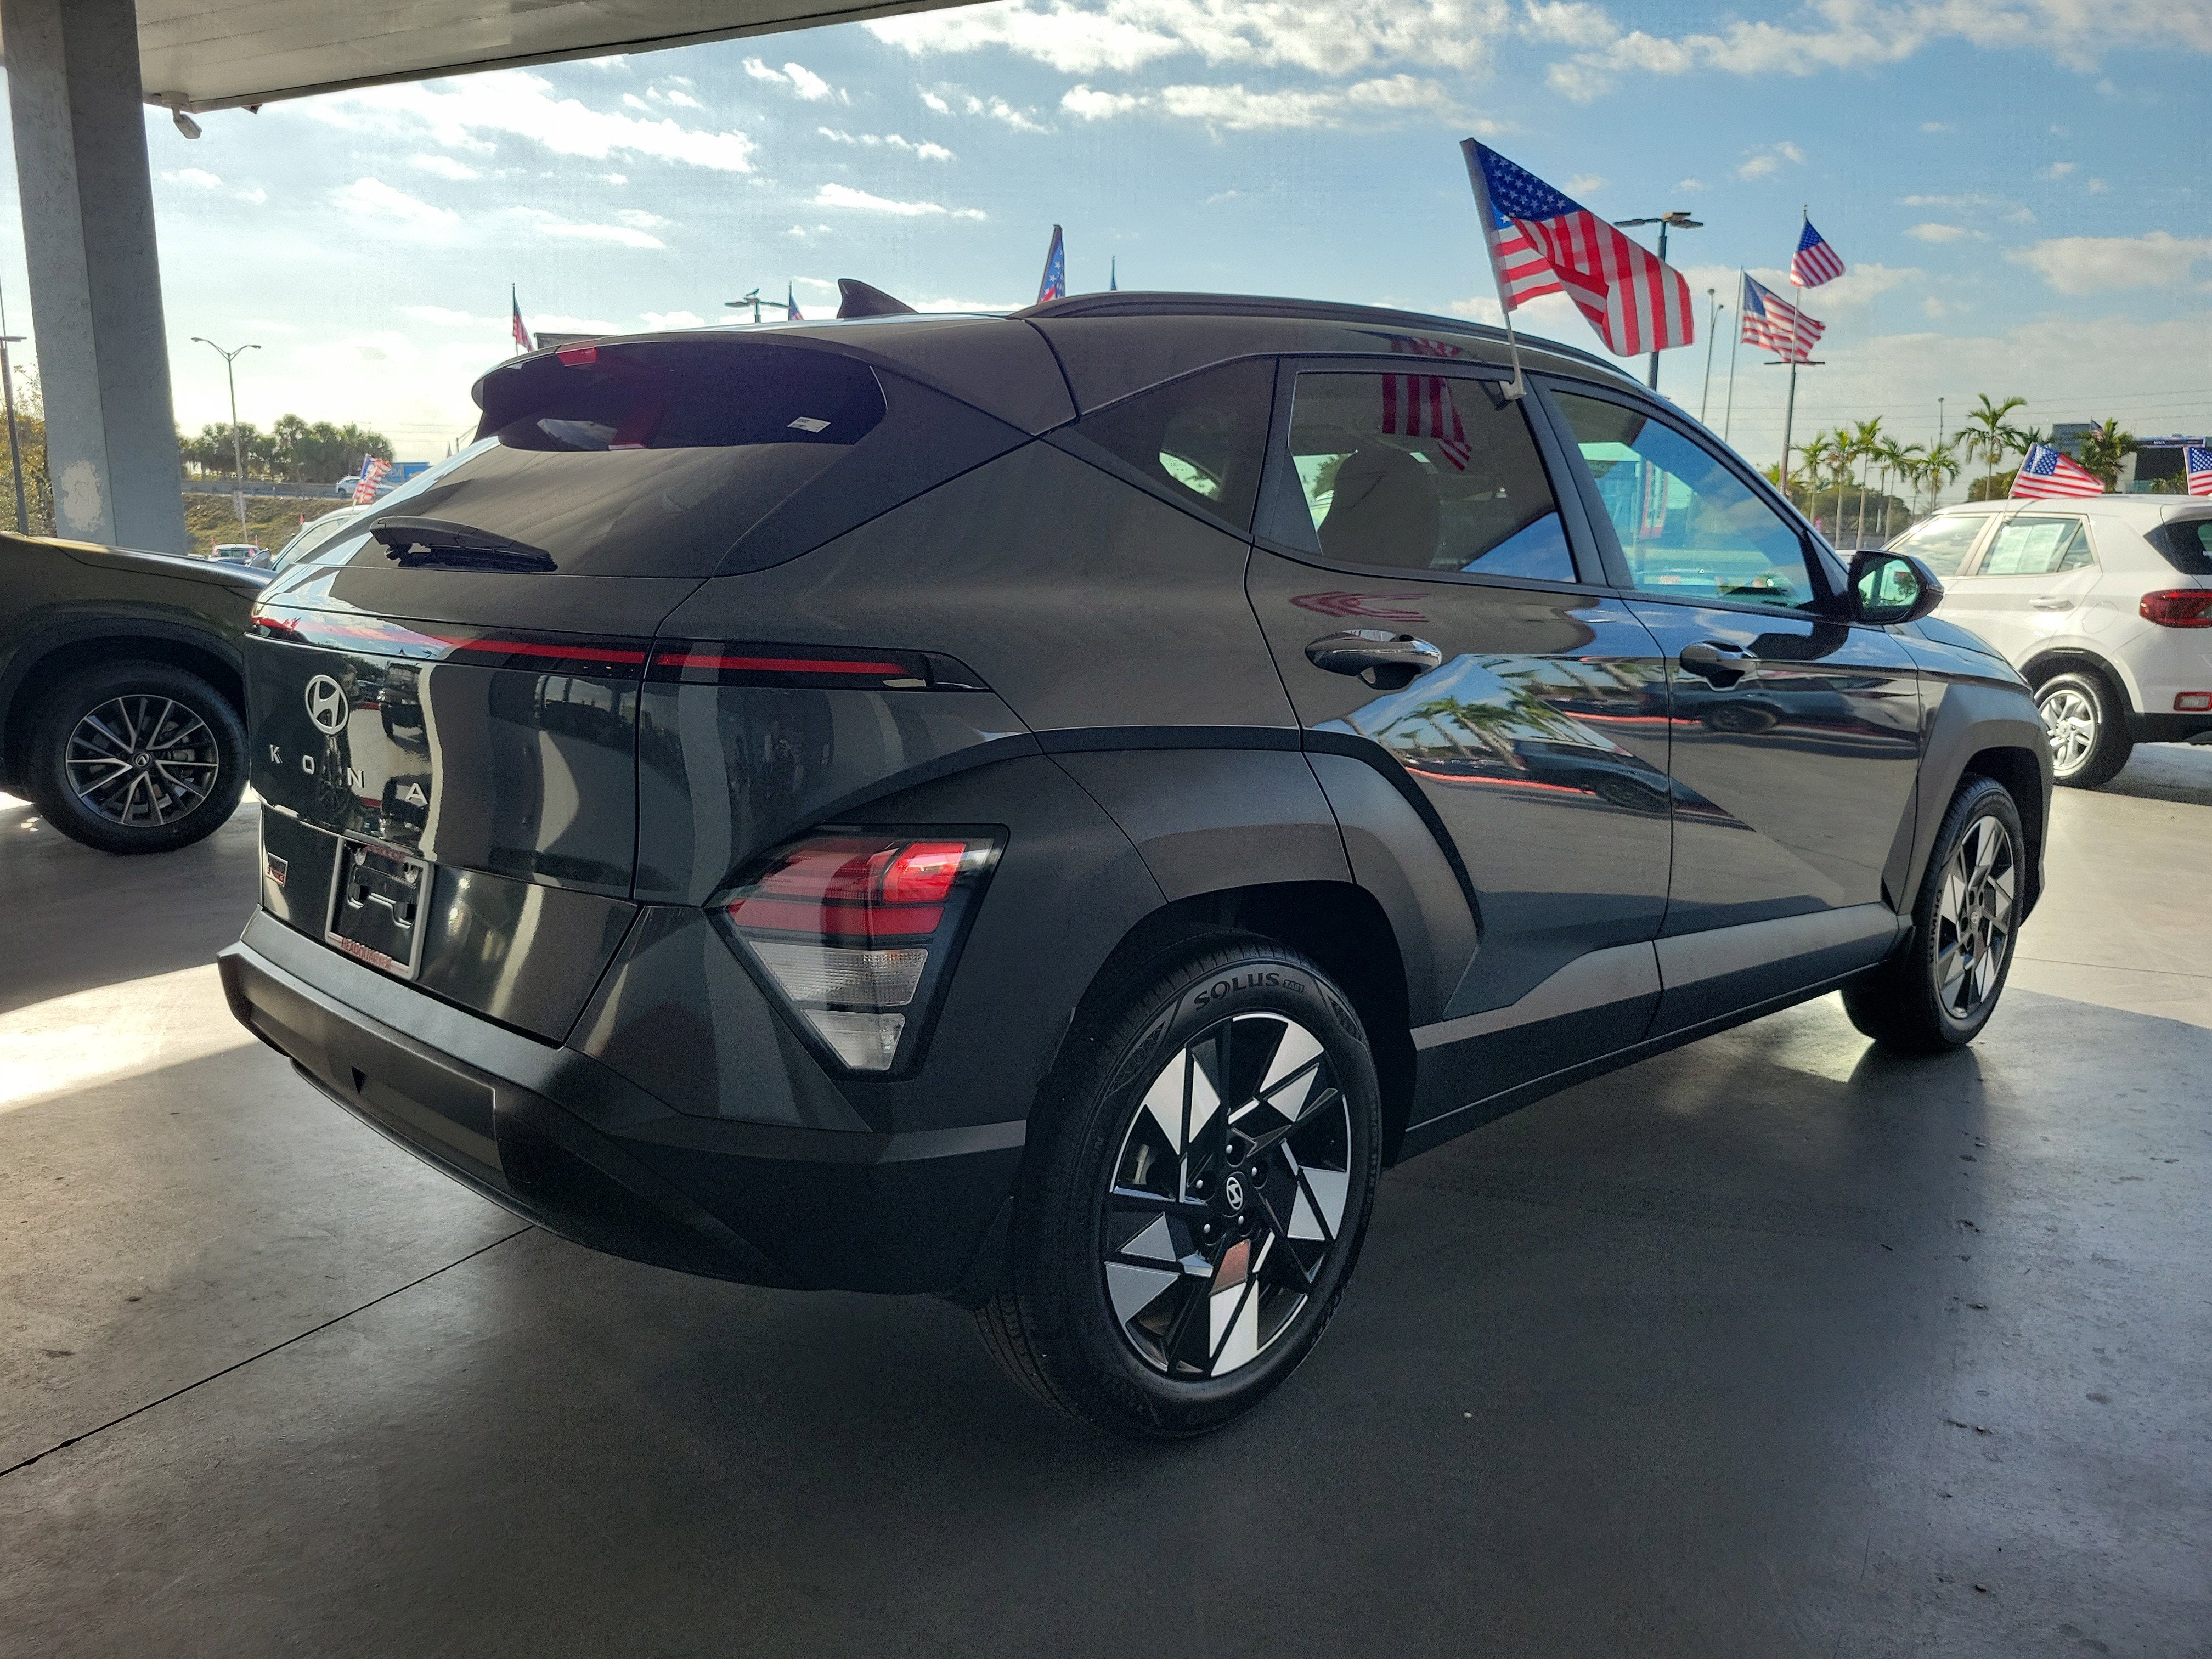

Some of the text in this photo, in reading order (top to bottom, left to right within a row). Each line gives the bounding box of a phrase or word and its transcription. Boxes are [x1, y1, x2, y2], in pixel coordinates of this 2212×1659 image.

[270, 744, 428, 804] KONA
[1929, 889, 1942, 962] KUMHO
[1194, 973, 1279, 1011] SOLUS
